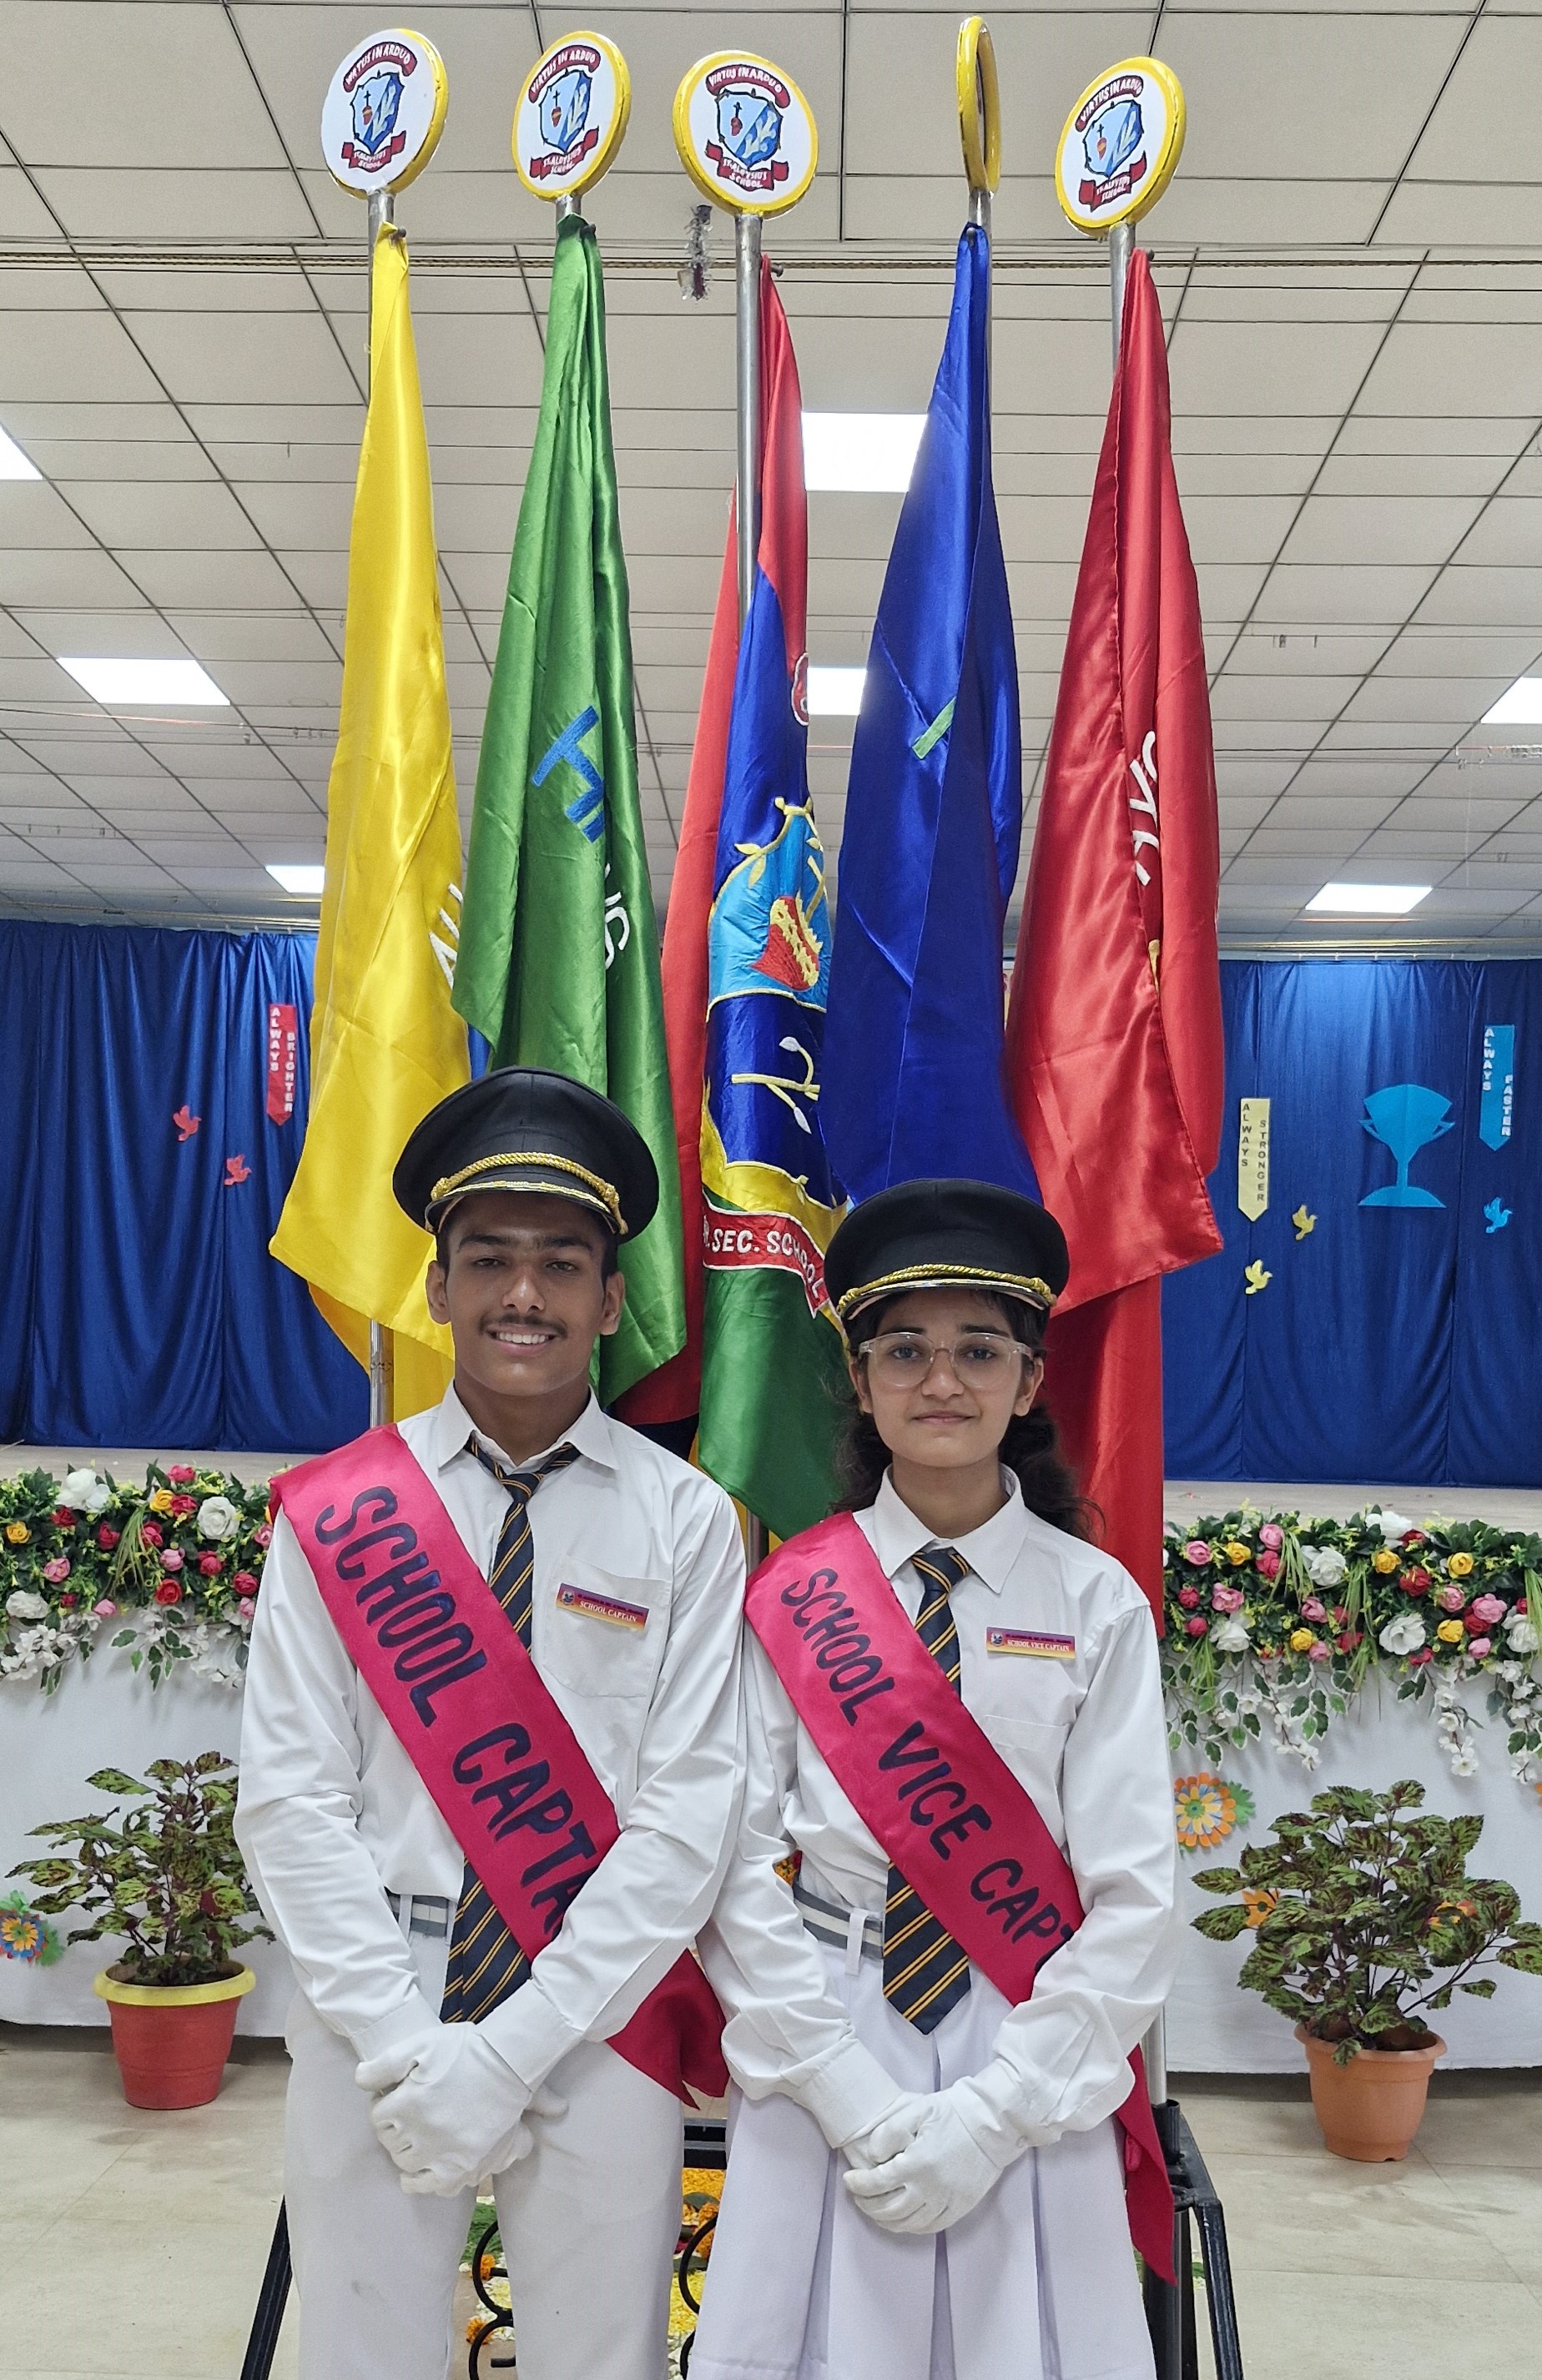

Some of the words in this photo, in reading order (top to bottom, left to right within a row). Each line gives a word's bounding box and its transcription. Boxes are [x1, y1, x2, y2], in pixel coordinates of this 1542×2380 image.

[383, 44, 411, 65] ARDUO
[531, 59, 557, 93] VIRTUS
[557, 51, 568, 65] IN
[569, 49, 596, 63] ARDUO
[708, 68, 737, 87] VIRTUS
[738, 67, 750, 78] IN
[749, 68, 783, 93] ARDUO
[1080, 86, 1110, 122] VIRTUS
[1110, 79, 1120, 96] IN
[728, 172, 763, 188] SCHOOL
[270, 1007, 282, 1071] ALWAYS
[1483, 1028, 1495, 1091] ALWAYS
[285, 1032, 295, 1112] BRIGHTER
[1241, 1103, 1252, 1167] ALWAYS
[1502, 1074, 1514, 1136] FASTER
[1257, 1120, 1267, 1201] STRONGER
[766, 1230, 824, 1299] SCHOOL
[314, 1486, 487, 1728] SCHOOL
[579, 1600, 607, 1615] SCHOOL
[607, 1609, 637, 1622] CAPTAIN
[1007, 1639, 1031, 1648] SCHOOL
[1045, 1643, 1070, 1652] CAPTAIN
[781, 1567, 895, 1727] SCHOOL
[877, 1720, 993, 1861] VICE
